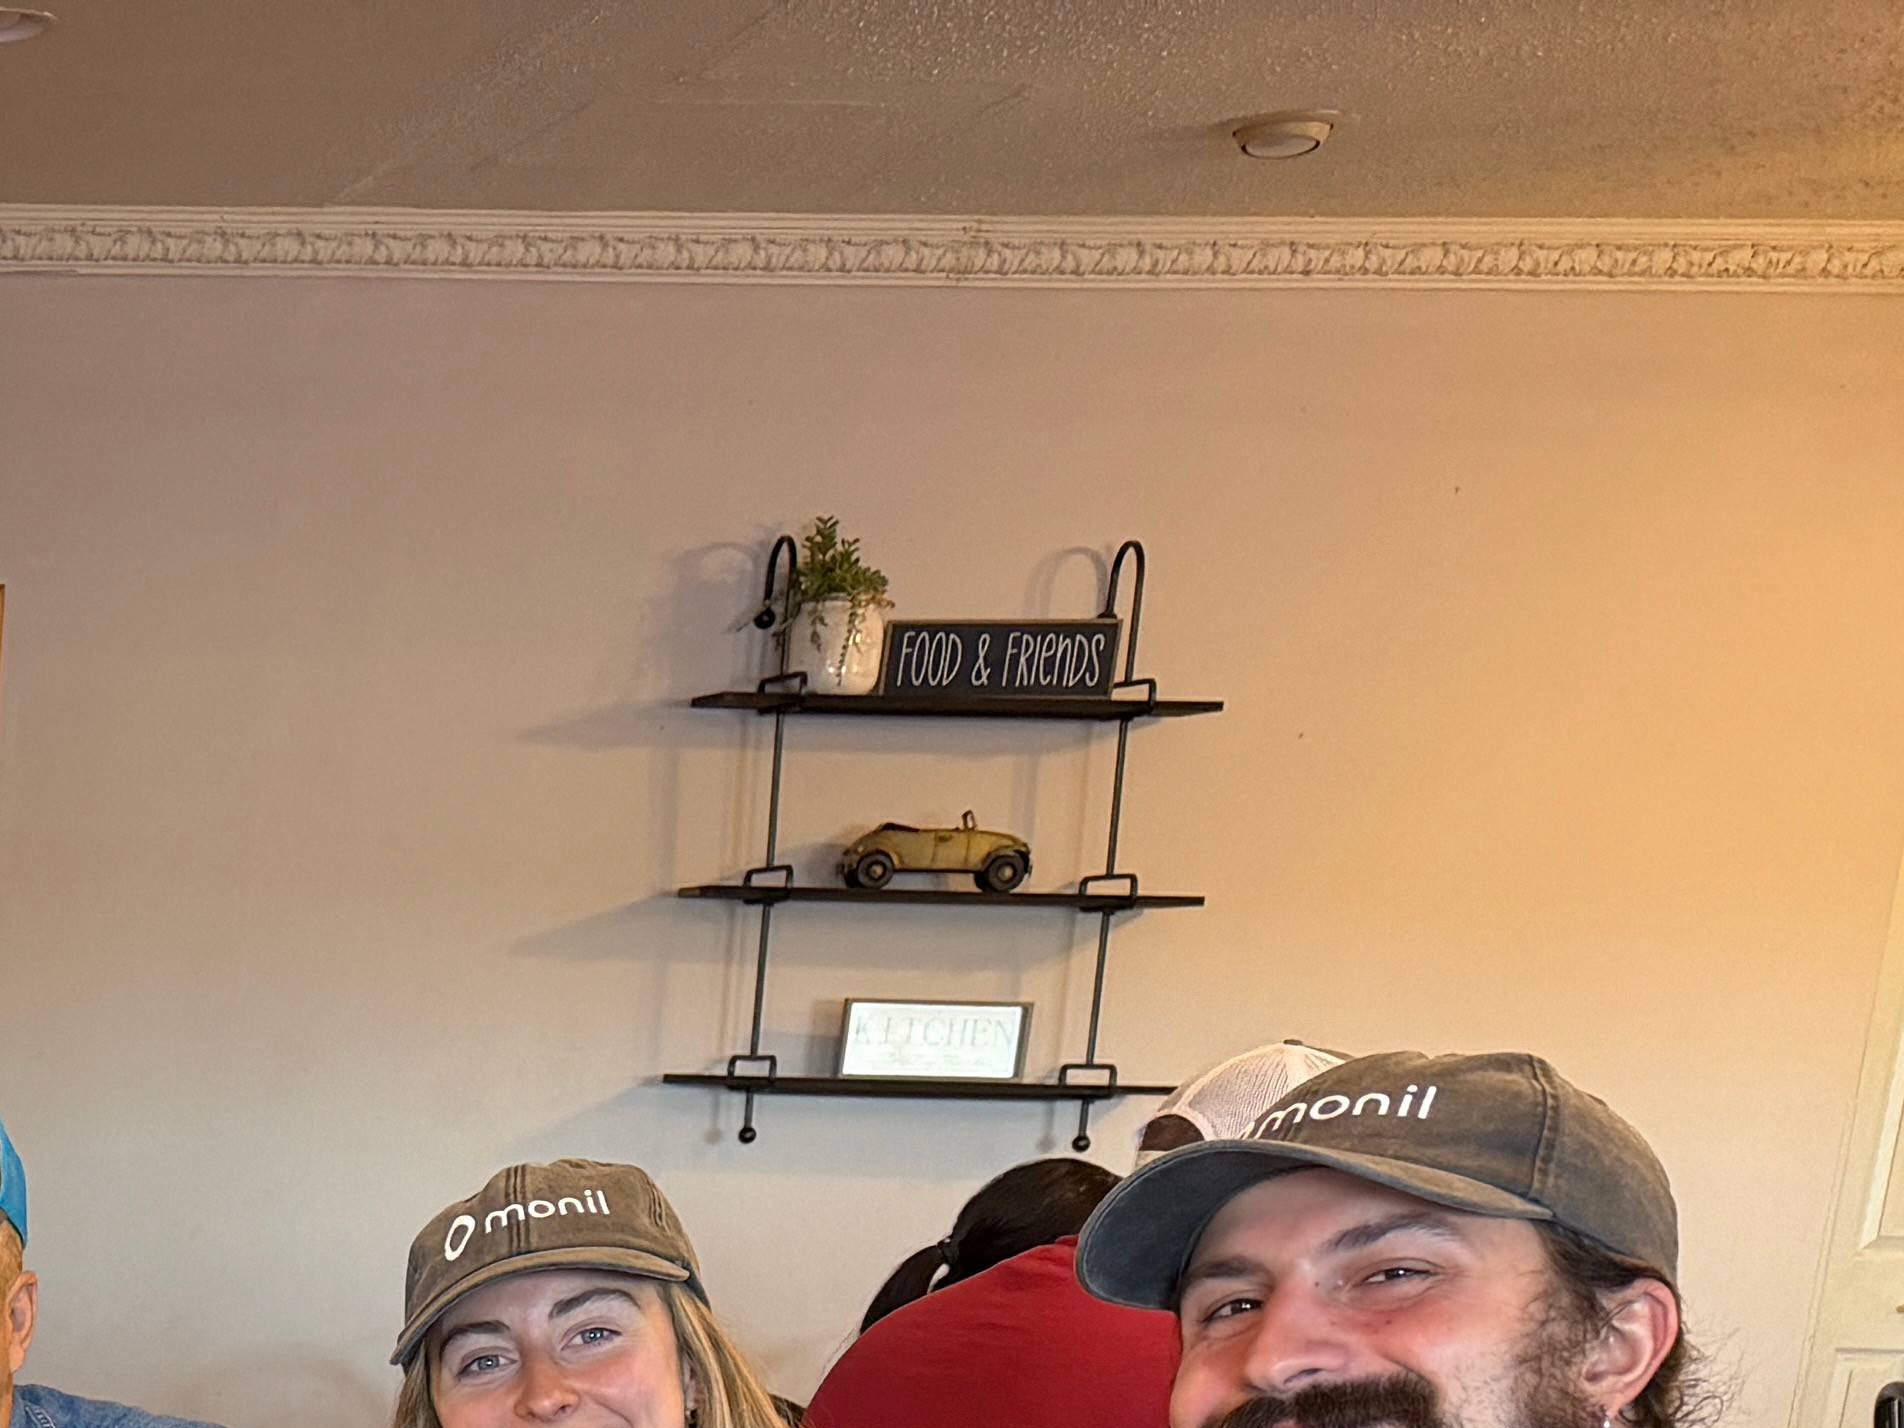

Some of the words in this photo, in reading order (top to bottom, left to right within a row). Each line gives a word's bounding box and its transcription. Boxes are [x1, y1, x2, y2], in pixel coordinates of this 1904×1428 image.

[897, 631, 962, 687] FOOD
[971, 633, 991, 686] &
[854, 1016, 1014, 1047] KITCHEN
[1254, 1084, 1437, 1141] monil
[485, 1190, 610, 1234] monil
